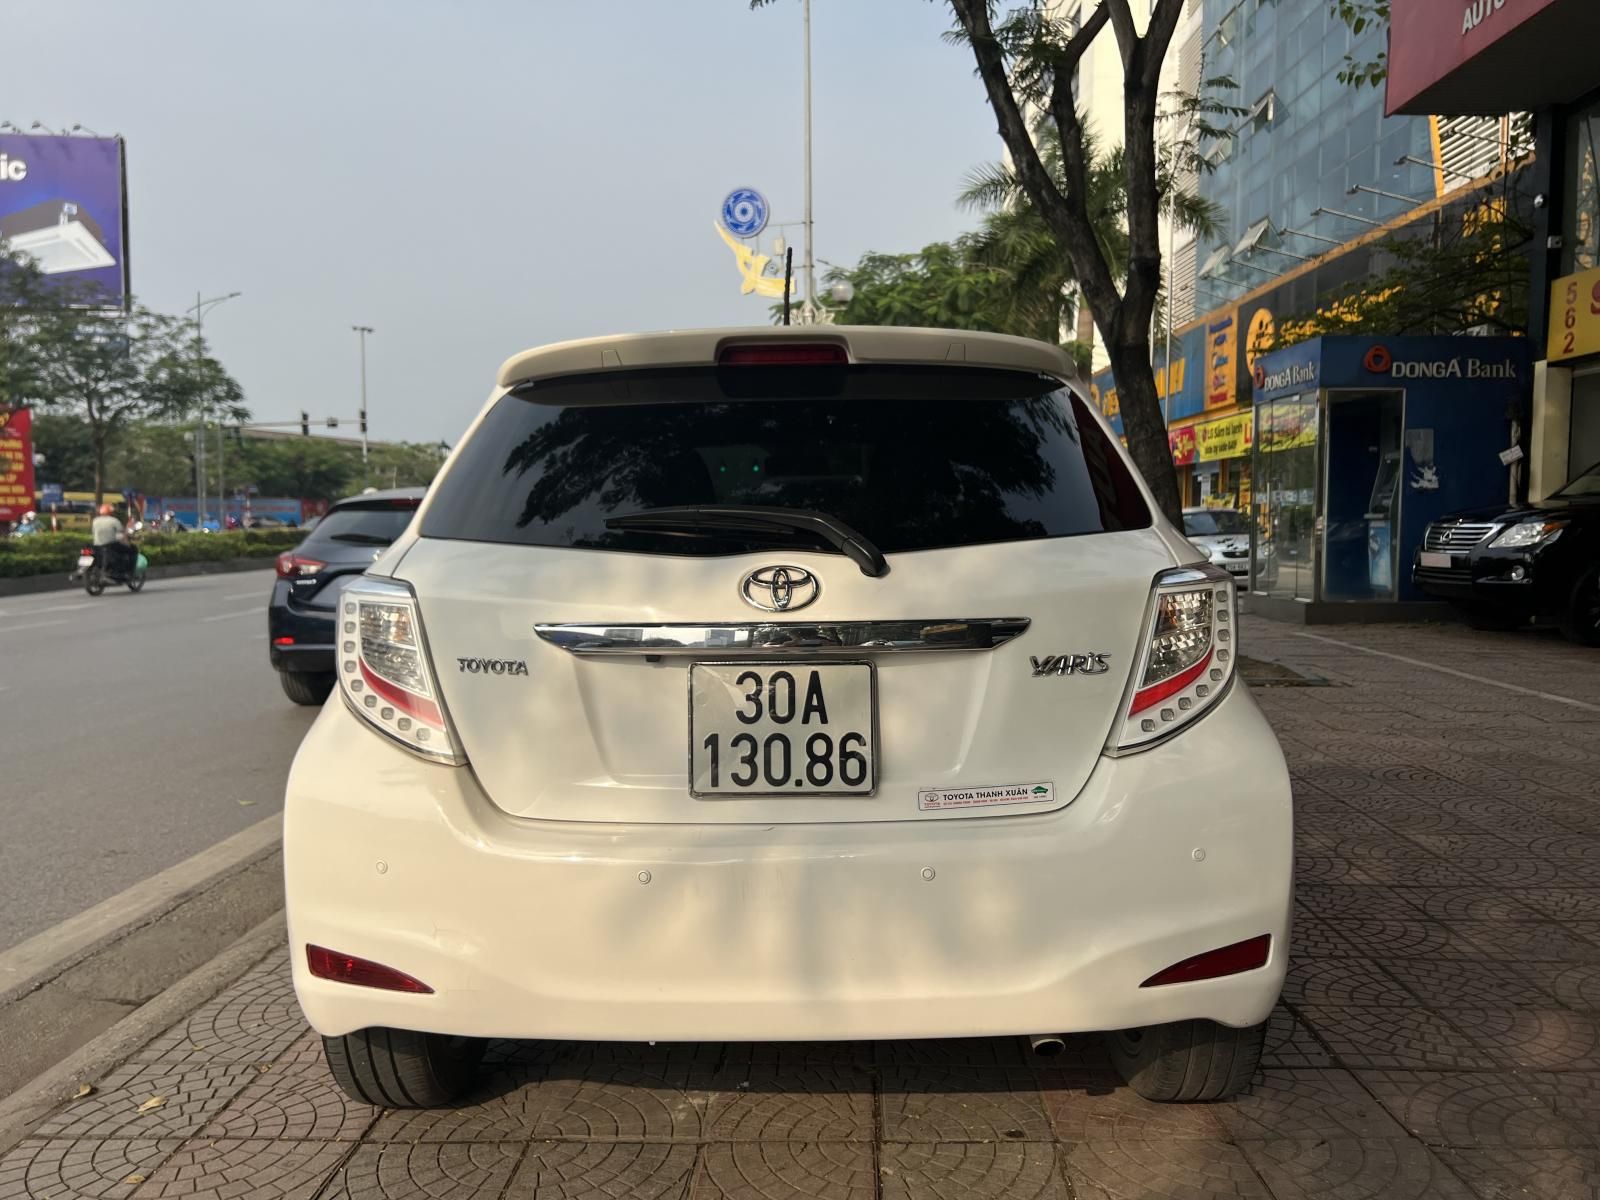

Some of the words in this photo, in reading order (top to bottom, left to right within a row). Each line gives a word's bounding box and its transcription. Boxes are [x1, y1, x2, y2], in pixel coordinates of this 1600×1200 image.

[1292, 361, 1315, 385] Bank
[1466, 358, 1517, 379] Bank
[456, 658, 529, 676] TOYOTA
[735, 670, 829, 725] 30A
[704, 731, 868, 788] 130.86
[943, 793, 974, 801] TOYOTA
[976, 790, 1003, 799] THANH
